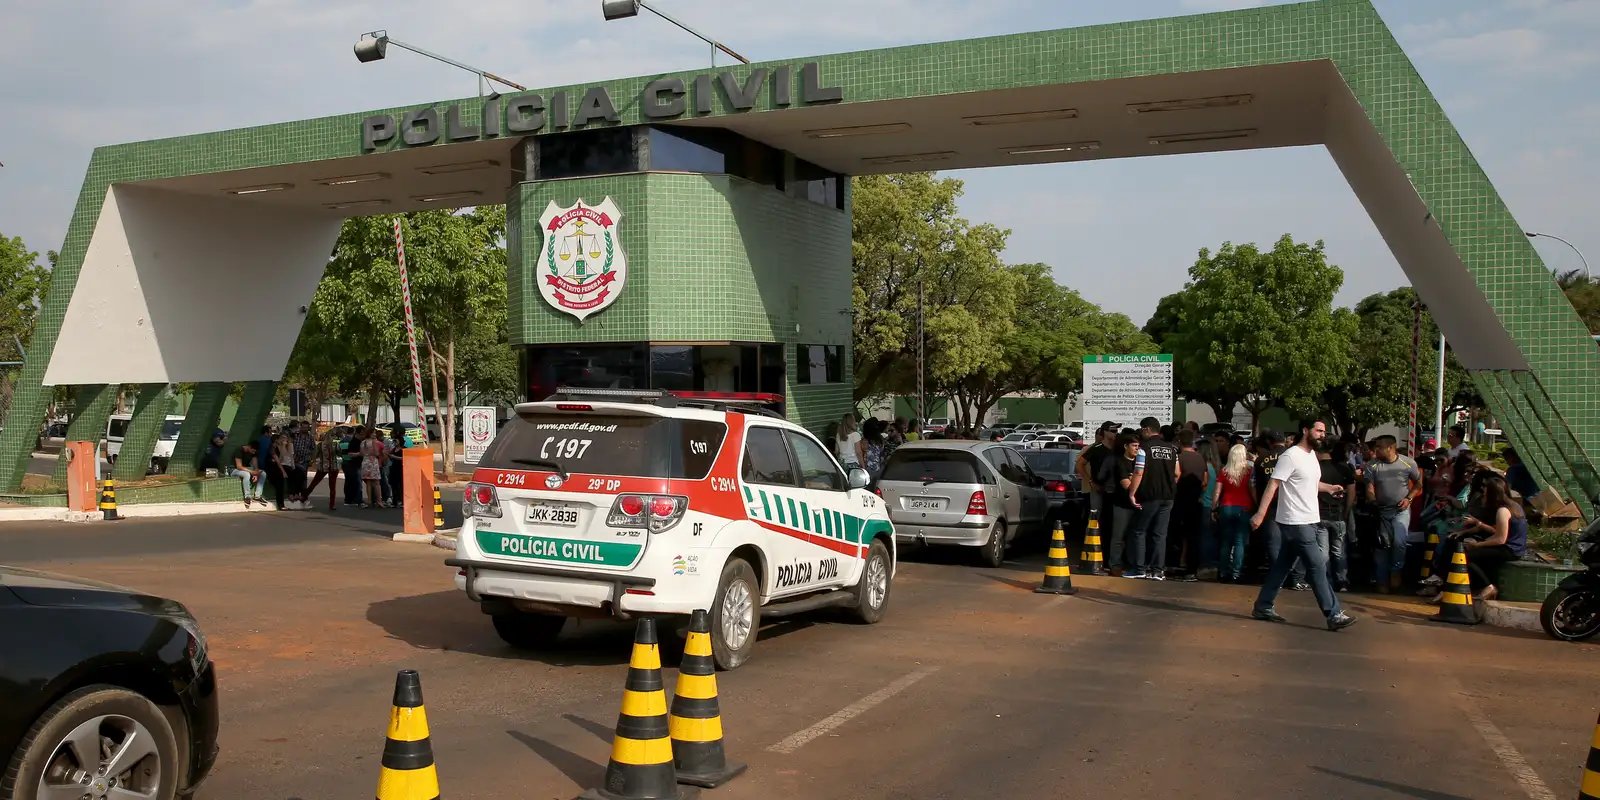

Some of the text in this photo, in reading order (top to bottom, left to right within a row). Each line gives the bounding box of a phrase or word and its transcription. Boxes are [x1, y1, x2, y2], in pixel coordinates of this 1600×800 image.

[363, 61, 844, 150] POLÍCIA CIVIL
[585, 210, 603, 224] CIVIL
[581, 278, 604, 293] FEDERAL
[555, 438, 593, 459] 197
[695, 441, 707, 453] 197
[497, 474, 525, 486] C 2914
[605, 479, 621, 491] DP
[711, 477, 736, 492] C 2914
[693, 522, 703, 536] DF
[501, 536, 604, 562] POLÍCIA CIVIL
[776, 557, 838, 589] POLÍCIA CIVIL
